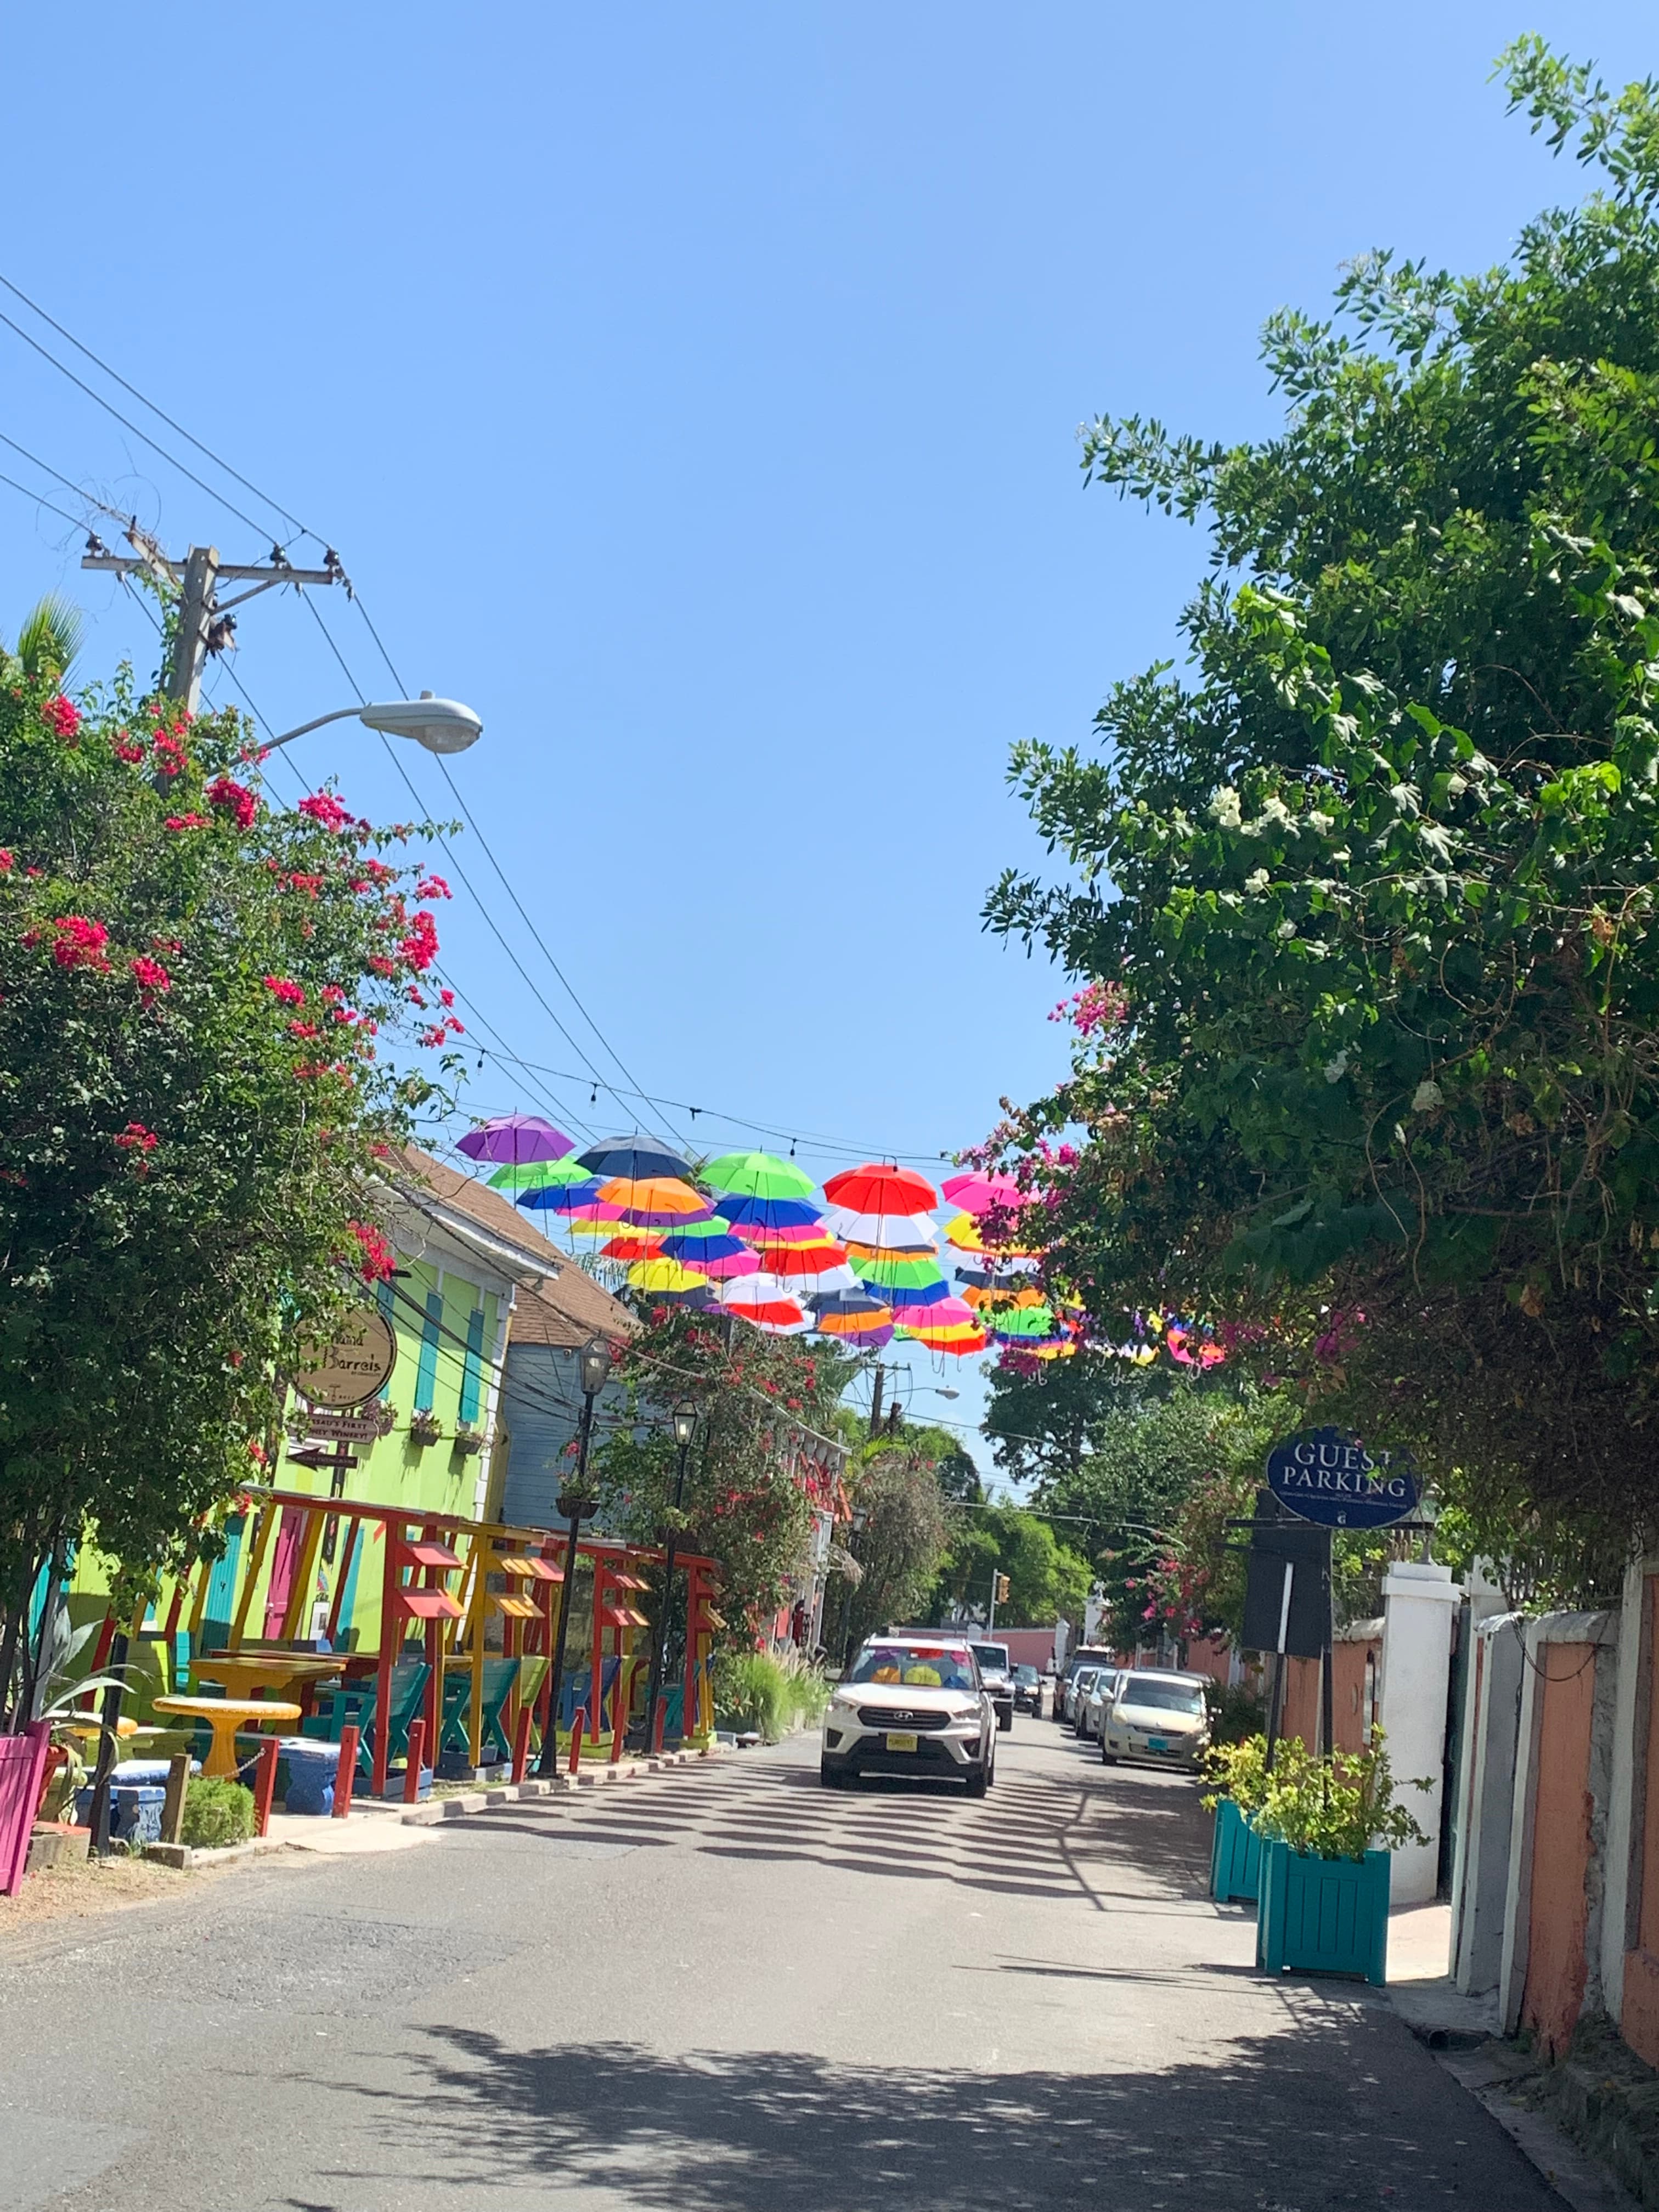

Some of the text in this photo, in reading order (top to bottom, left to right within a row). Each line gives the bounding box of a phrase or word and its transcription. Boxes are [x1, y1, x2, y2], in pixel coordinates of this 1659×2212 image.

[342, 1420, 366, 1430] FIRST
[1294, 1443, 1392, 1472] GUEST
[1282, 1466, 1406, 1497] PARKING
